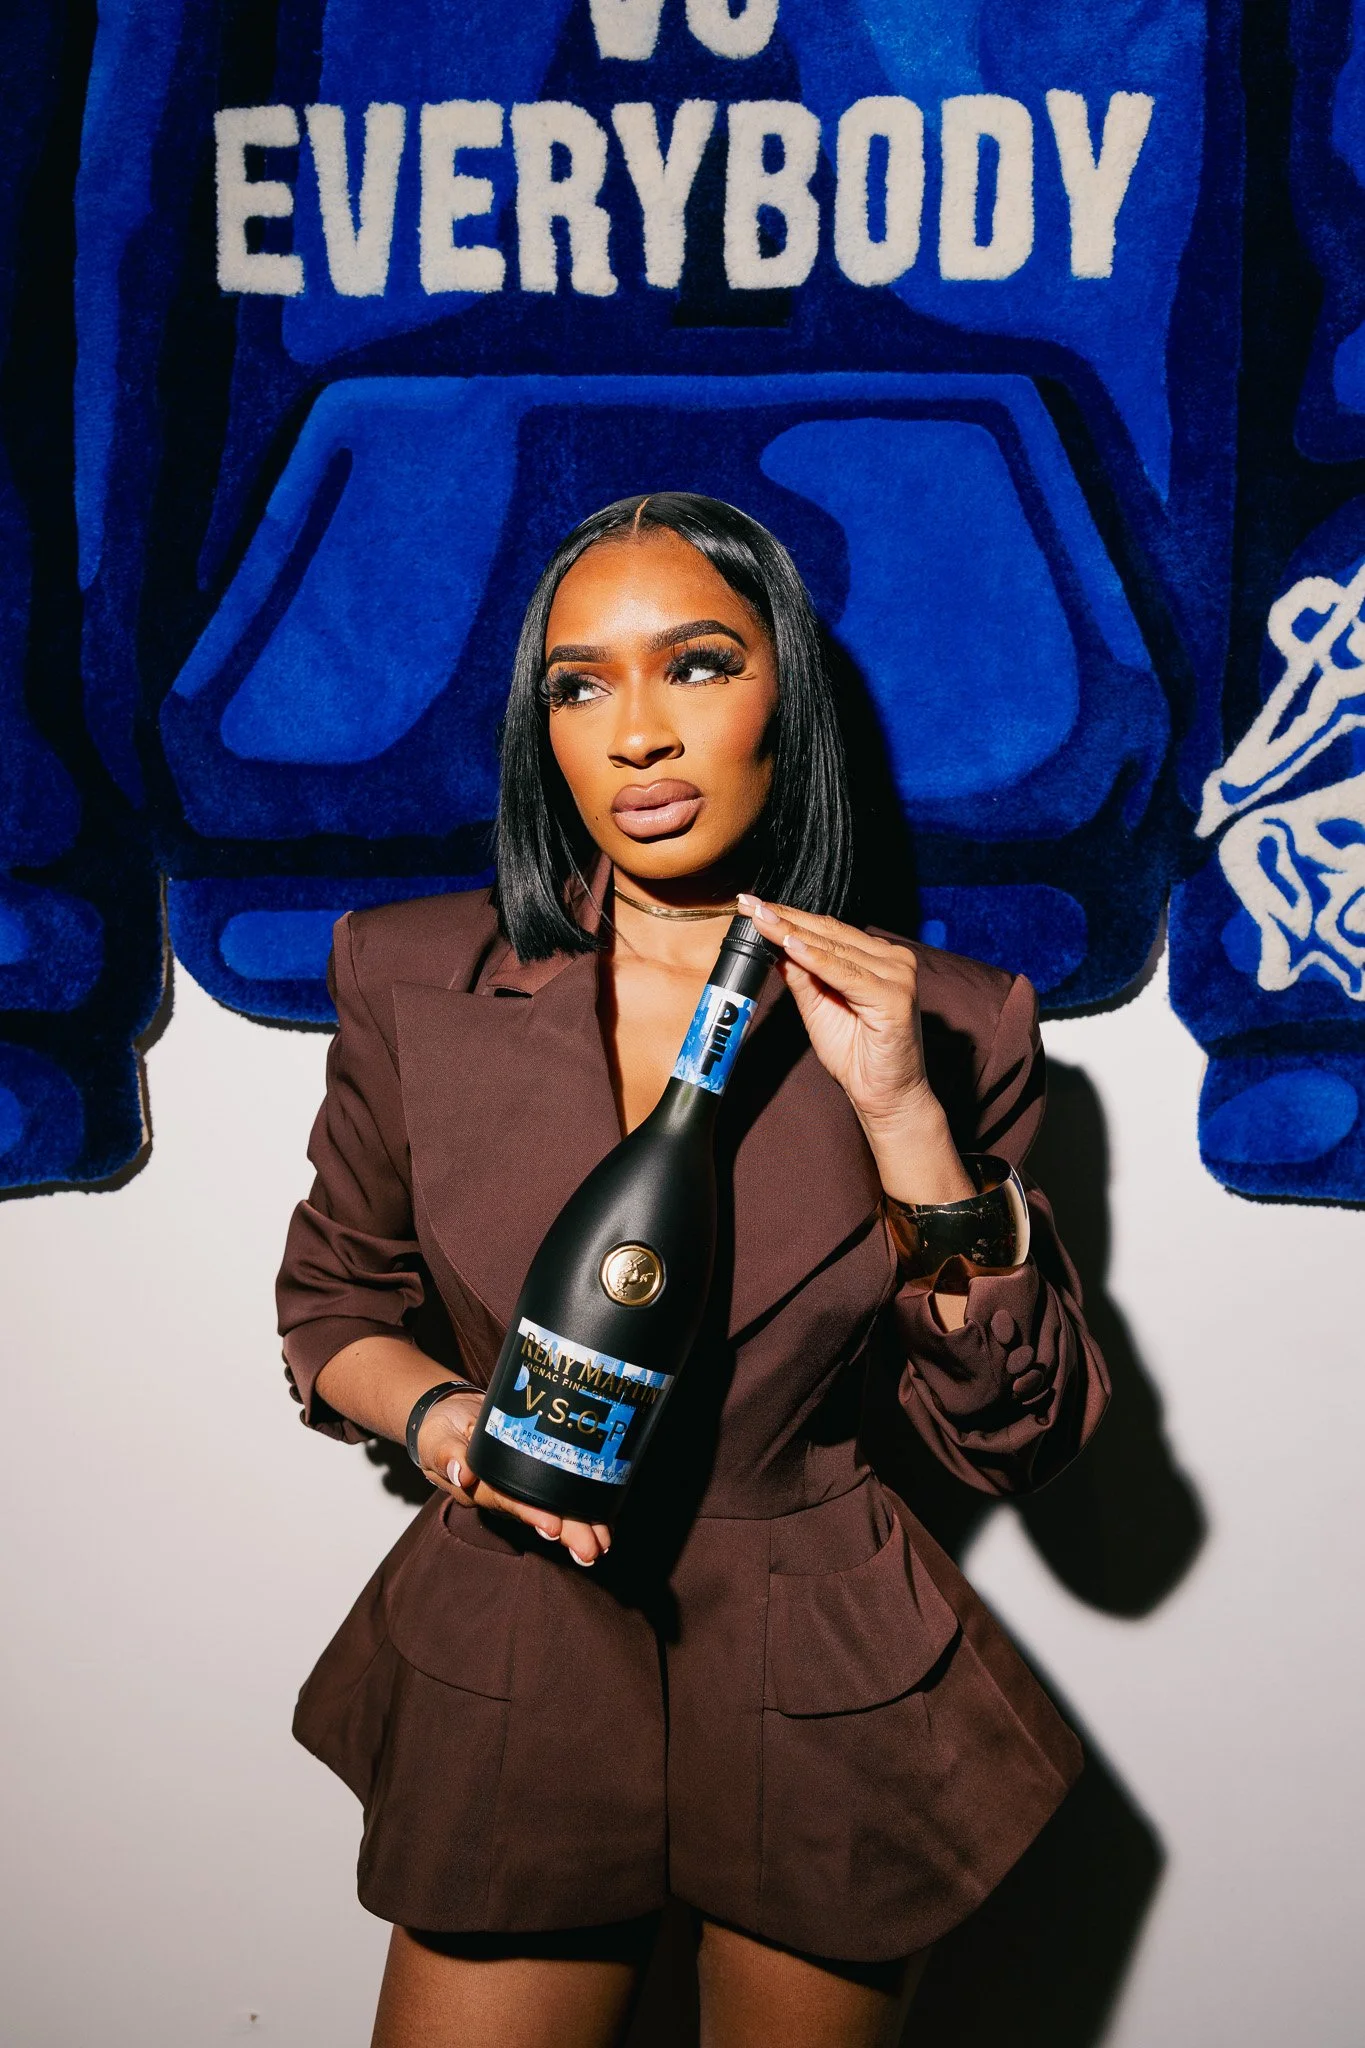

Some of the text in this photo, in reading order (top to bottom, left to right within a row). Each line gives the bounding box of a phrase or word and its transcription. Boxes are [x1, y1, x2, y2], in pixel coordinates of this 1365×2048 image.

[214, 88, 1154, 296] EVERYBODY
[520, 1331, 577, 1376] RÉMY
[578, 1357, 661, 1404] MARTIN
[521, 1359, 588, 1394] COGNAC FINE
[521, 1429, 604, 1466] PRODUCT OF FRANCE
